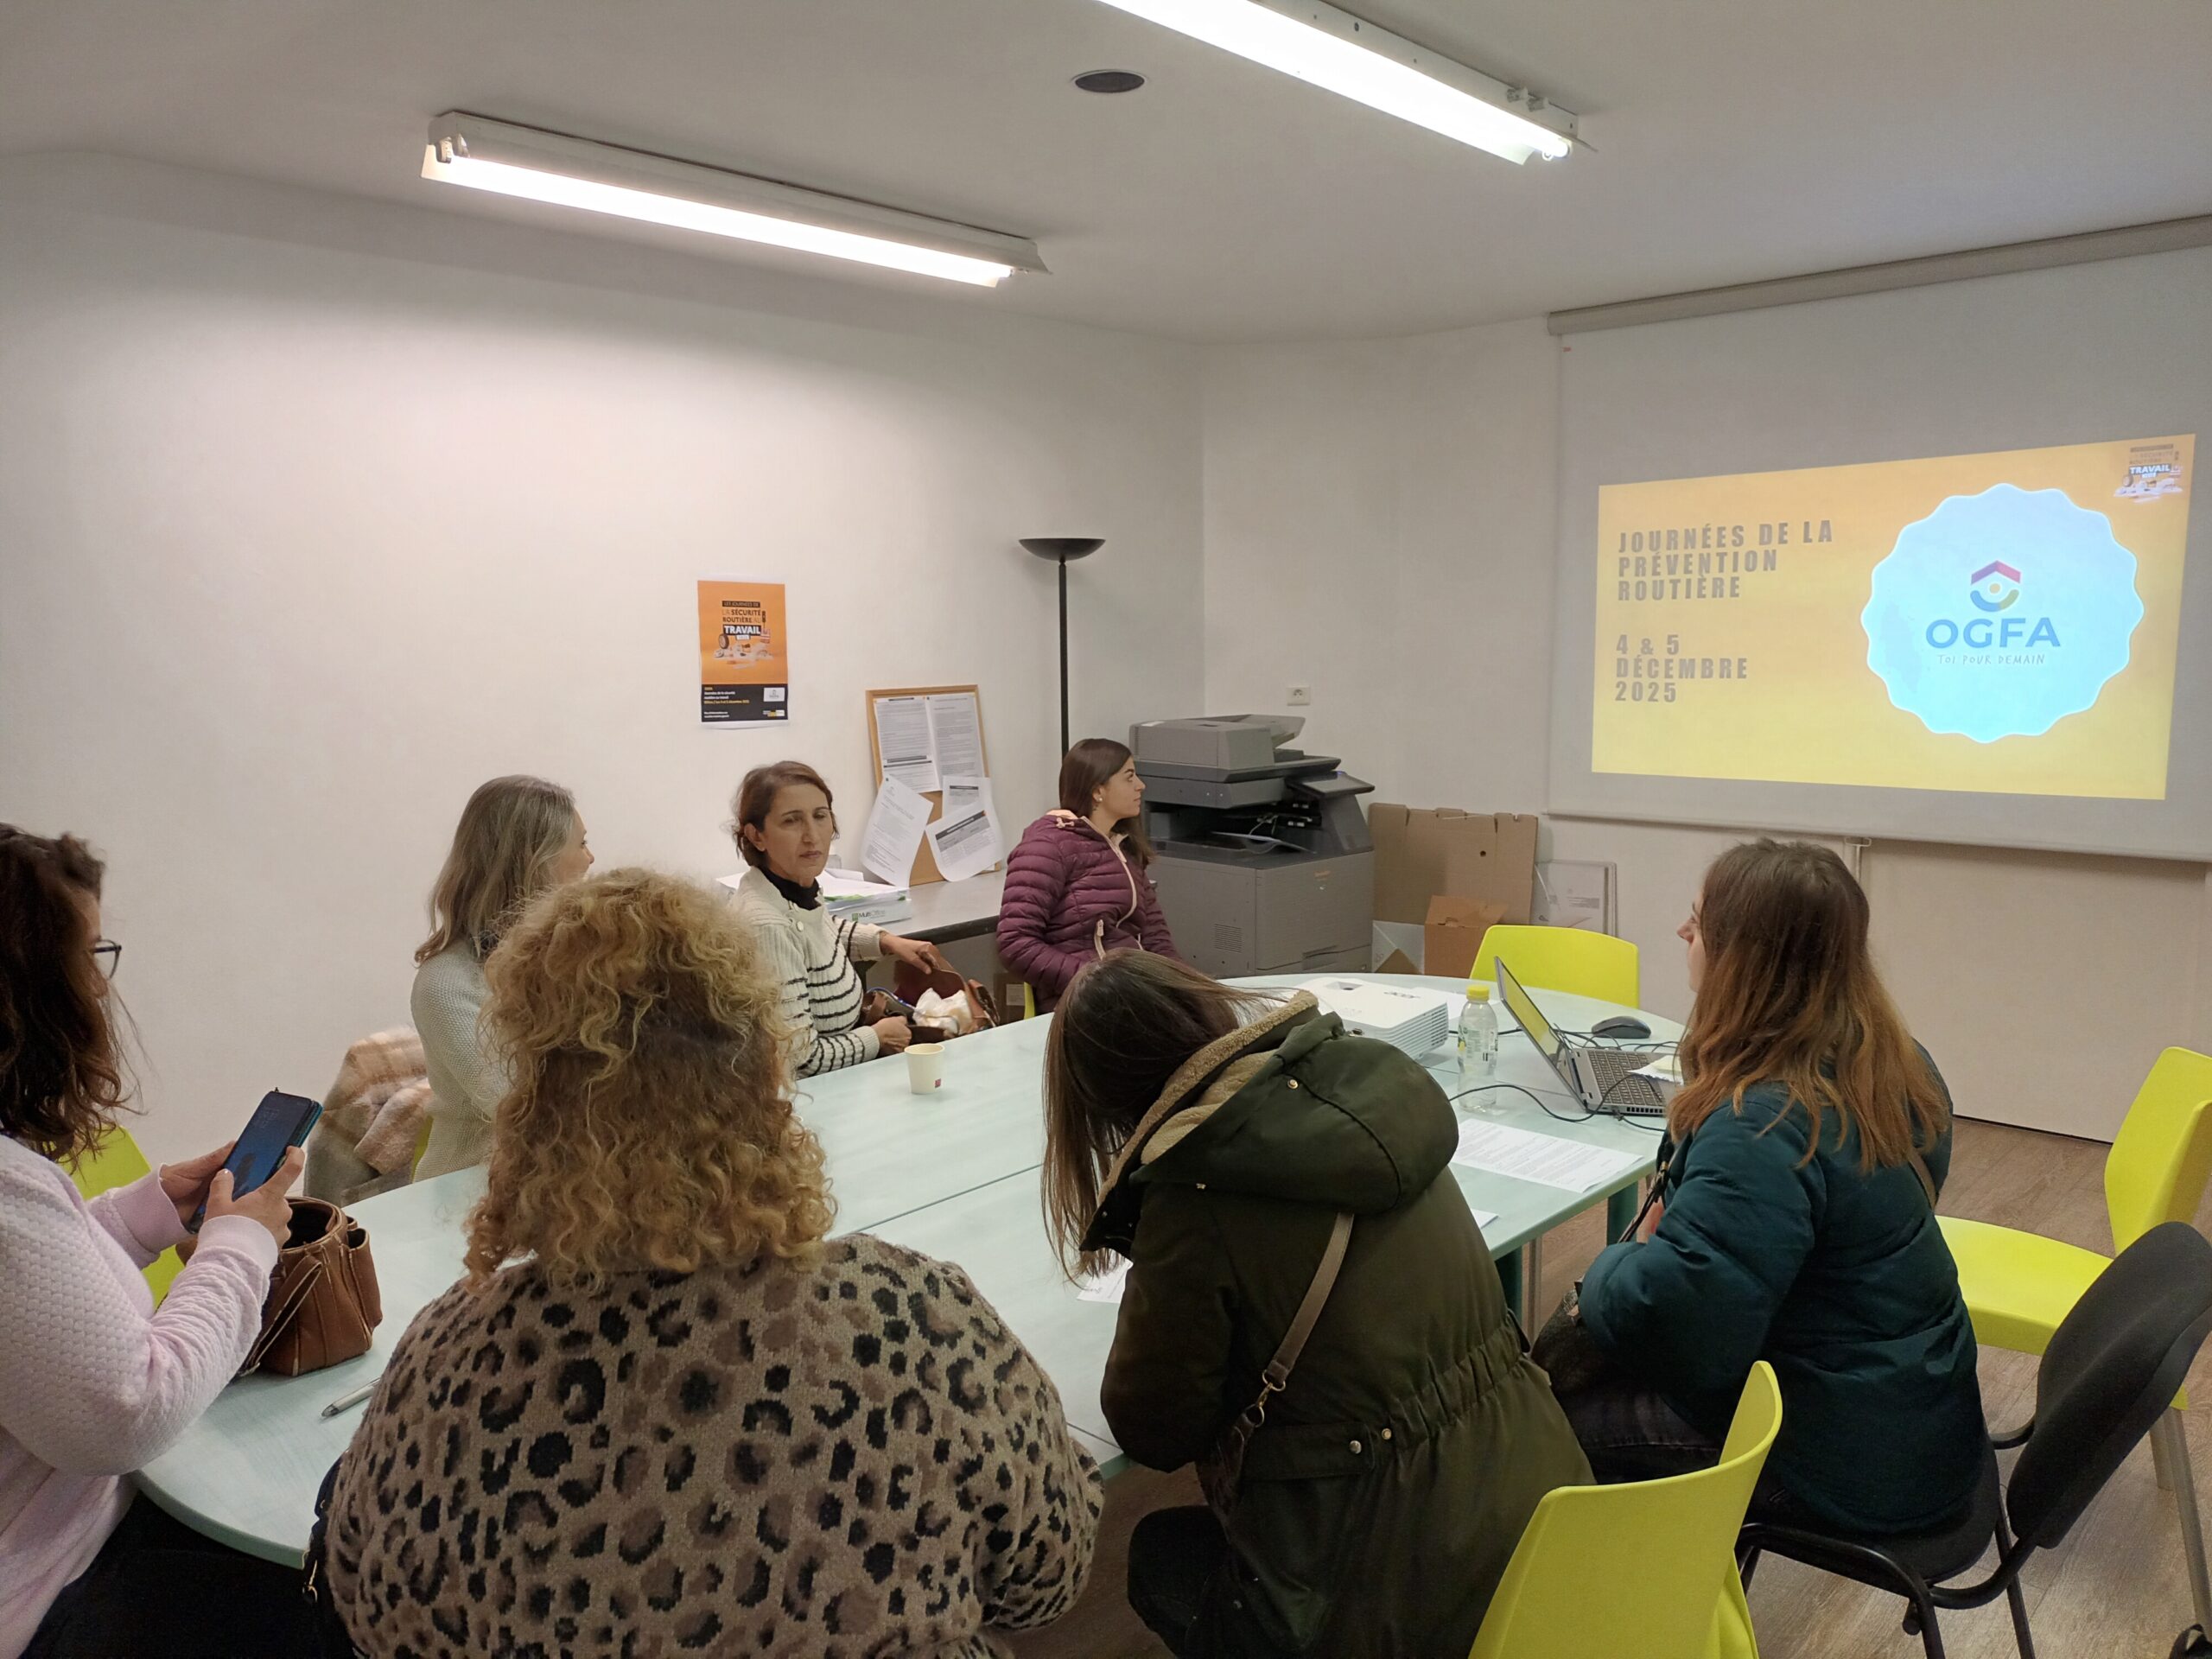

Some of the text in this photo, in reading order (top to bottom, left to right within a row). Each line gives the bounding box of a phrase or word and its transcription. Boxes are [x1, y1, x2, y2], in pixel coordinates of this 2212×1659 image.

[2130, 464, 2171, 474] TRAVAIL
[1618, 519, 1832, 553] JOURNÉES DE LA
[1618, 549, 1777, 577] PRÉVENTION
[1618, 574, 1740, 601] ROUTIÈRE
[724, 625, 761, 634] TRAVAIL
[1925, 617, 2061, 648] OGFA
[1616, 634, 1679, 655] 4 & 5
[1616, 654, 1747, 679] DÉCEMBRE
[1937, 653, 2045, 664] TOI POUR DEMAIN
[1615, 681, 1676, 702] 2025
